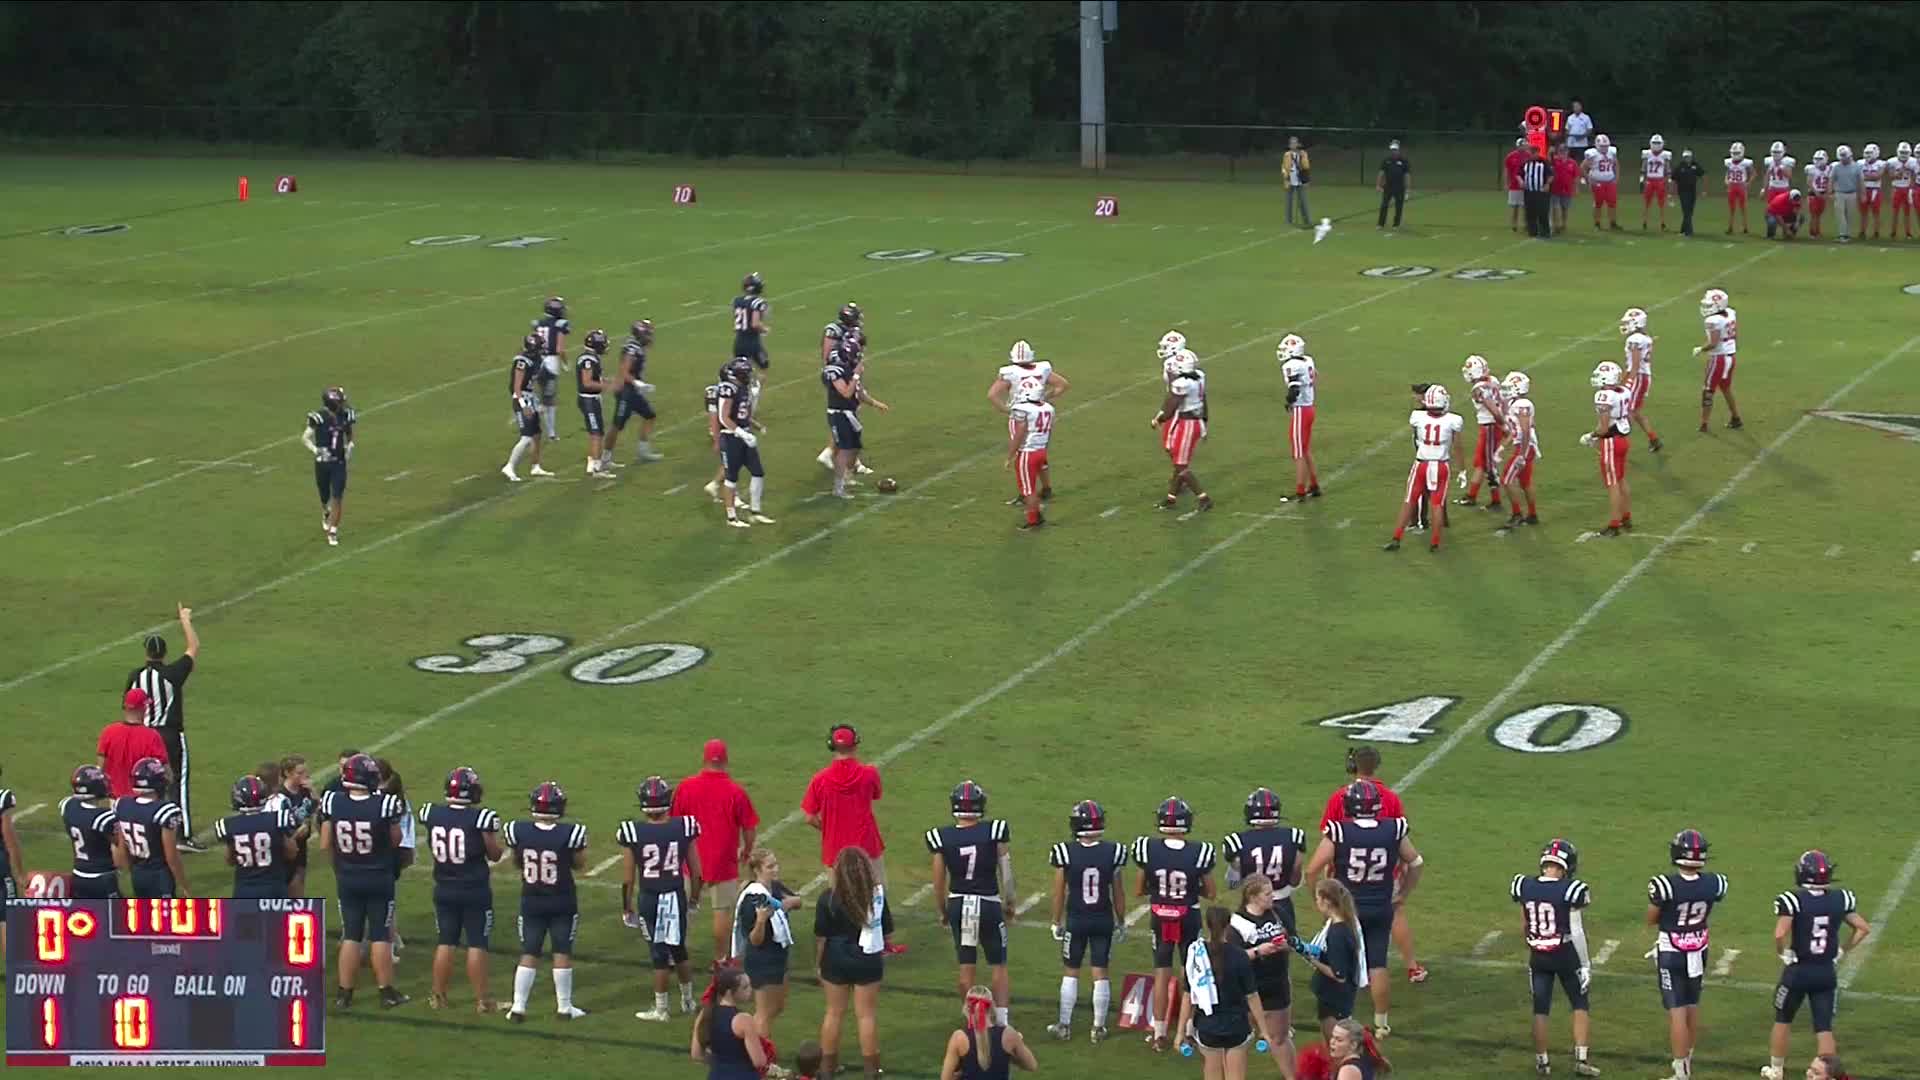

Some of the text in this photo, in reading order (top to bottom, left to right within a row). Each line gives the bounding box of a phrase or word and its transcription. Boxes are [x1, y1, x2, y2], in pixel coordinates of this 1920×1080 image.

[1552, 112, 1560, 131] 1
[278, 177, 289, 193] G
[674, 186, 691, 202] 10
[1095, 199, 1114, 216] 20
[735, 307, 748, 330] 21
[1035, 411, 1051, 433] 47
[1424, 424, 1441, 446] 11
[414, 633, 706, 684] 30
[1319, 695, 1624, 752] 40
[70, 826, 89, 861] 2
[119, 820, 151, 859] 55
[234, 832, 272, 867] 58
[335, 820, 373, 854] 65
[431, 826, 466, 864] 60
[522, 848, 558, 885] 66
[642, 841, 679, 878] 24
[959, 845, 977, 880] 7
[1251, 845, 1283, 881] 14
[1347, 847, 1388, 882] 52
[1082, 867, 1100, 904] 0
[1155, 868, 1187, 899] 18
[1525, 901, 1556, 936] 10
[1809, 915, 1829, 955] 5
